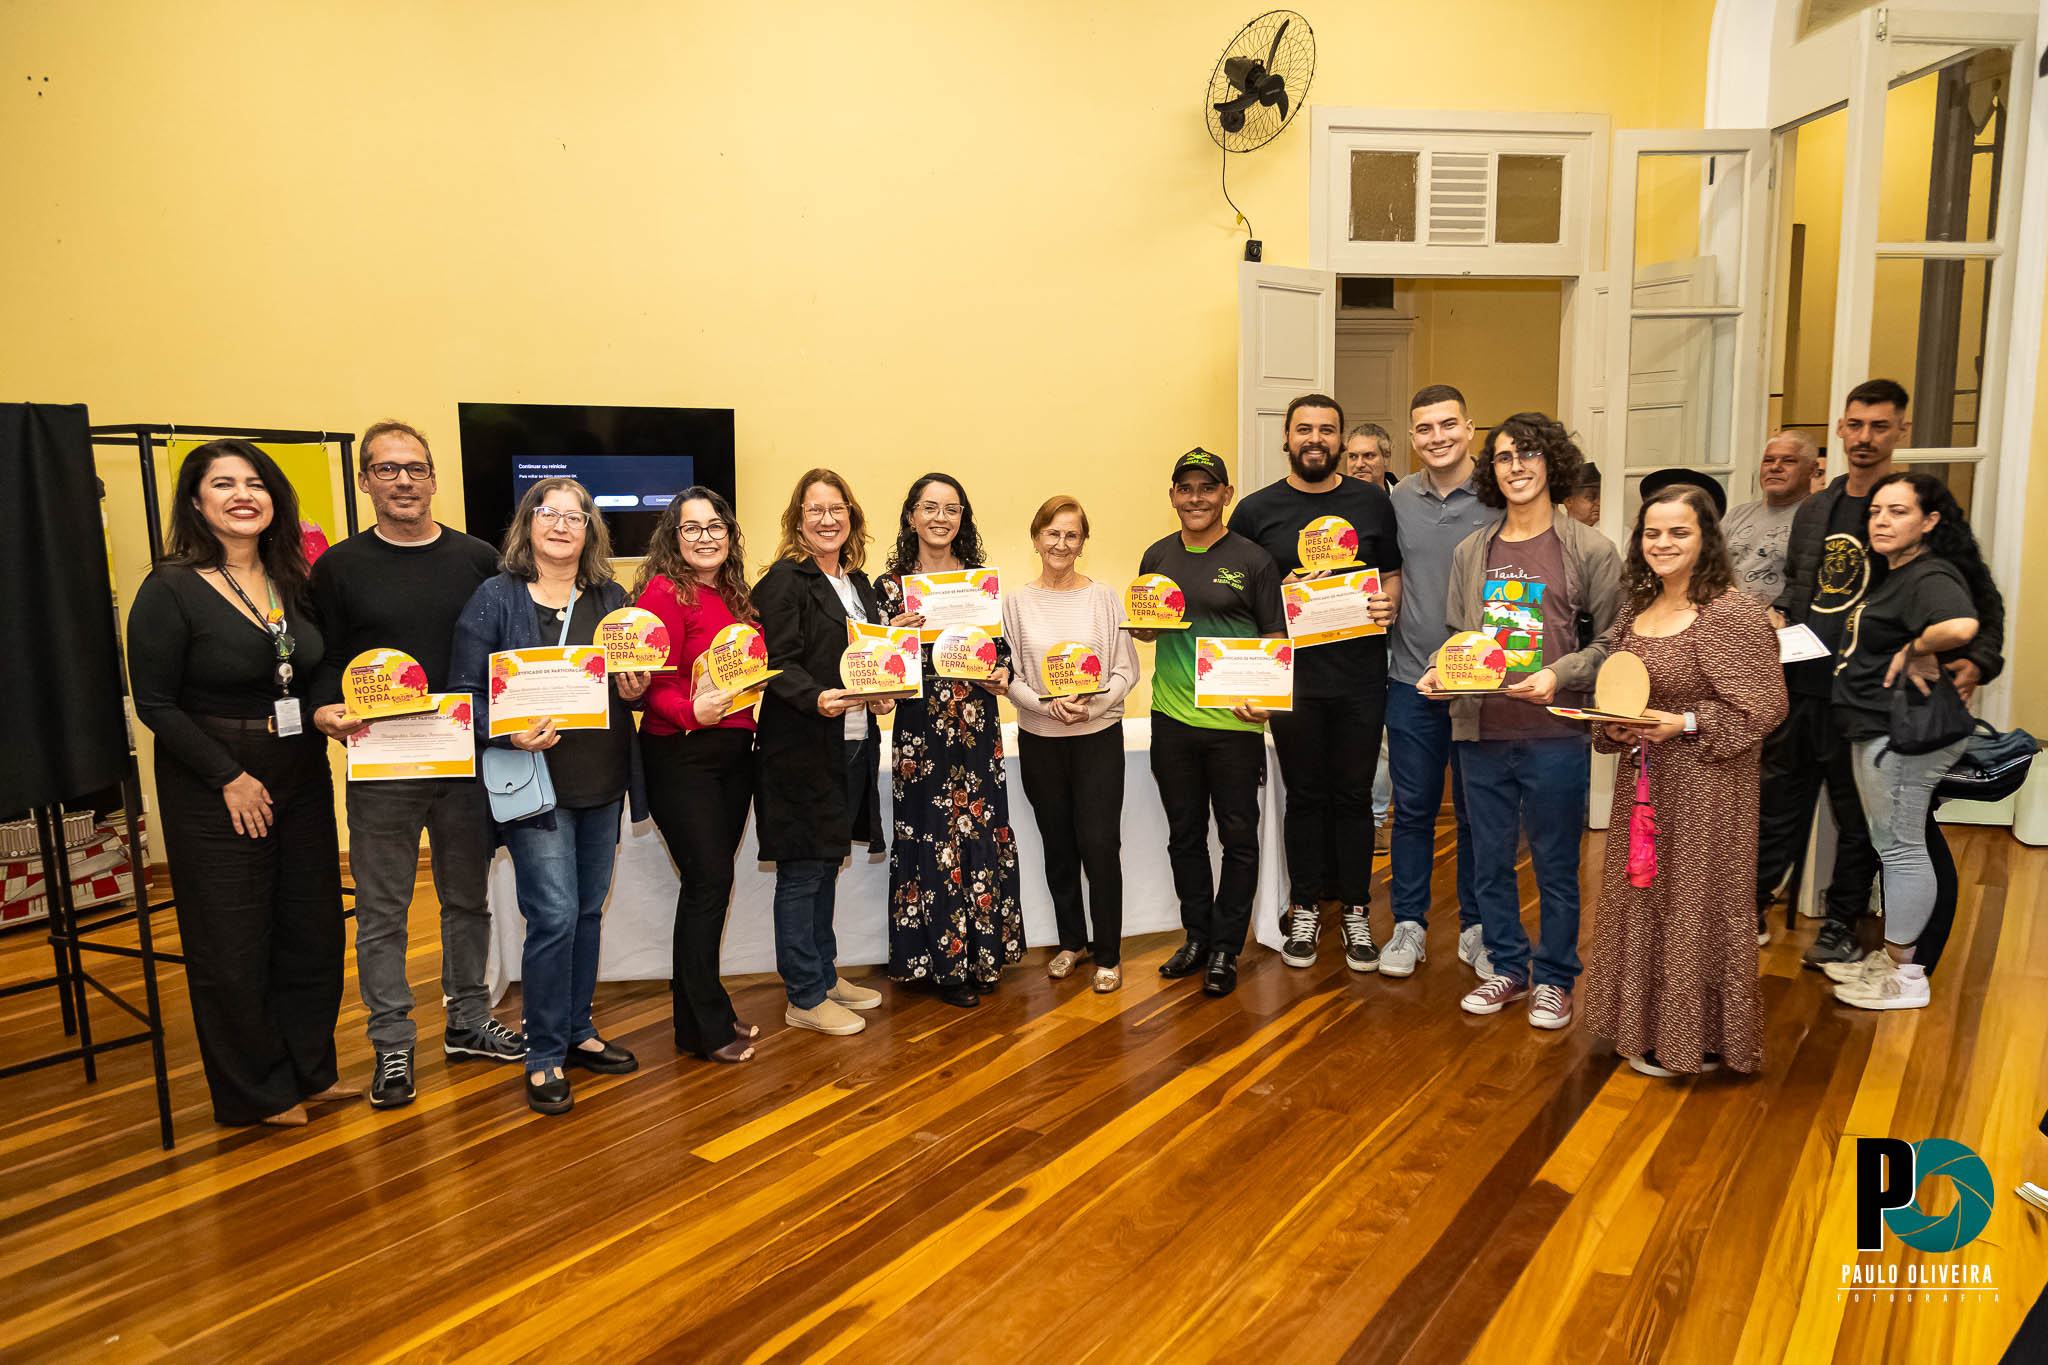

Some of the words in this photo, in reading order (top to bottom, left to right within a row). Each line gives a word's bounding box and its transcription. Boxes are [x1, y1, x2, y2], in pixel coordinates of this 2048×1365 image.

[1306, 536, 1322, 546] IPÊS
[1306, 544, 1331, 553] NOSSA
[1306, 552, 1330, 560] TERRA
[1131, 592, 1148, 600] IPÊS
[603, 630, 623, 640] IPÊS
[626, 632, 638, 640] DA
[604, 642, 636, 650] NOSSA
[714, 652, 731, 664] IPÊS
[732, 648, 743, 658] DA
[1446, 652, 1463, 661] IPÊS
[717, 658, 743, 674] NOSSA
[1048, 662, 1064, 670] IPÊS
[720, 668, 744, 682] TERRA
[849, 669, 878, 677] NOSSA
[352, 675, 376, 685] IPÊS
[377, 674, 392, 683] DA
[851, 678, 878, 686] TERRA
[354, 684, 390, 695] NOSSA
[356, 694, 390, 704] TERRA
